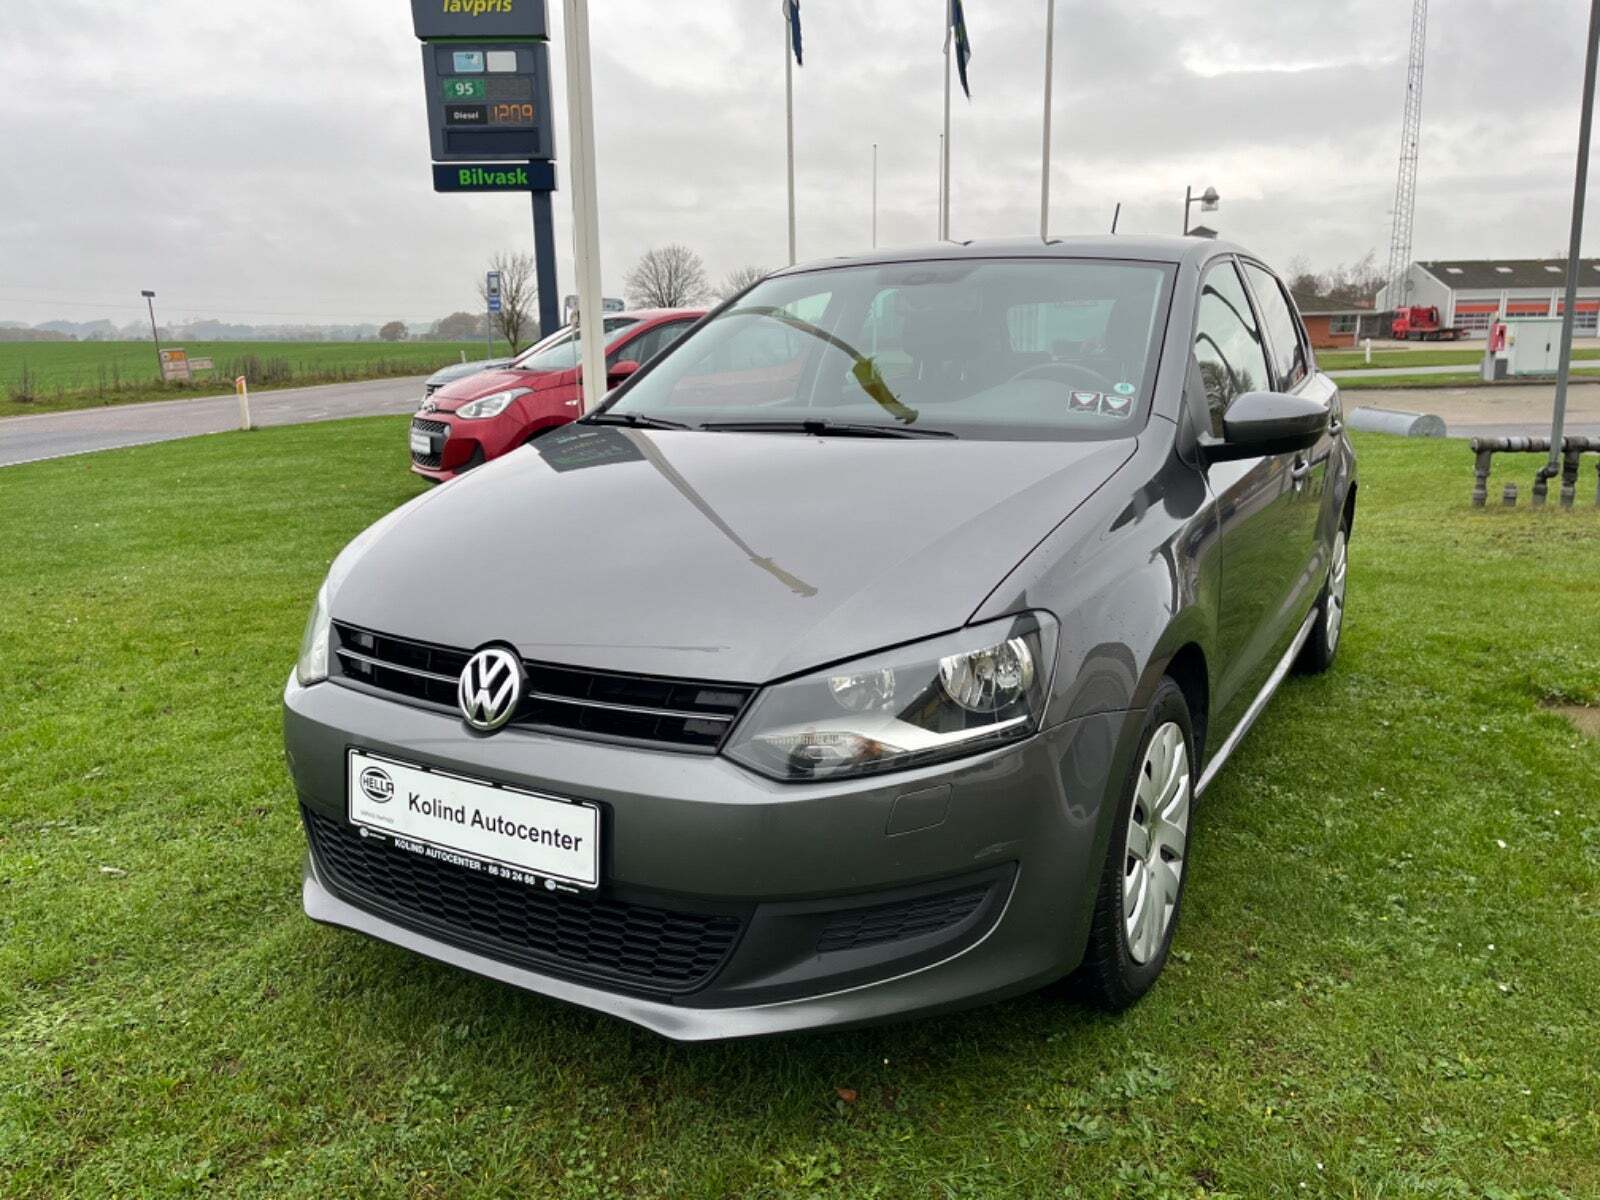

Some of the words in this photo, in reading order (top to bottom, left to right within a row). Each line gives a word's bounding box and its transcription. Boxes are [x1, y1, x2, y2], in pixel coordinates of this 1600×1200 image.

[455, 82, 474, 95] 95
[453, 111, 479, 119] Diesel
[458, 168, 528, 185] Bilvask
[362, 776, 395, 796] HELLA
[408, 792, 465, 824] Kolind
[470, 808, 583, 851] Autocenter
[394, 838, 425, 855] KOLIND
[425, 848, 481, 871] AUTOCENTER
